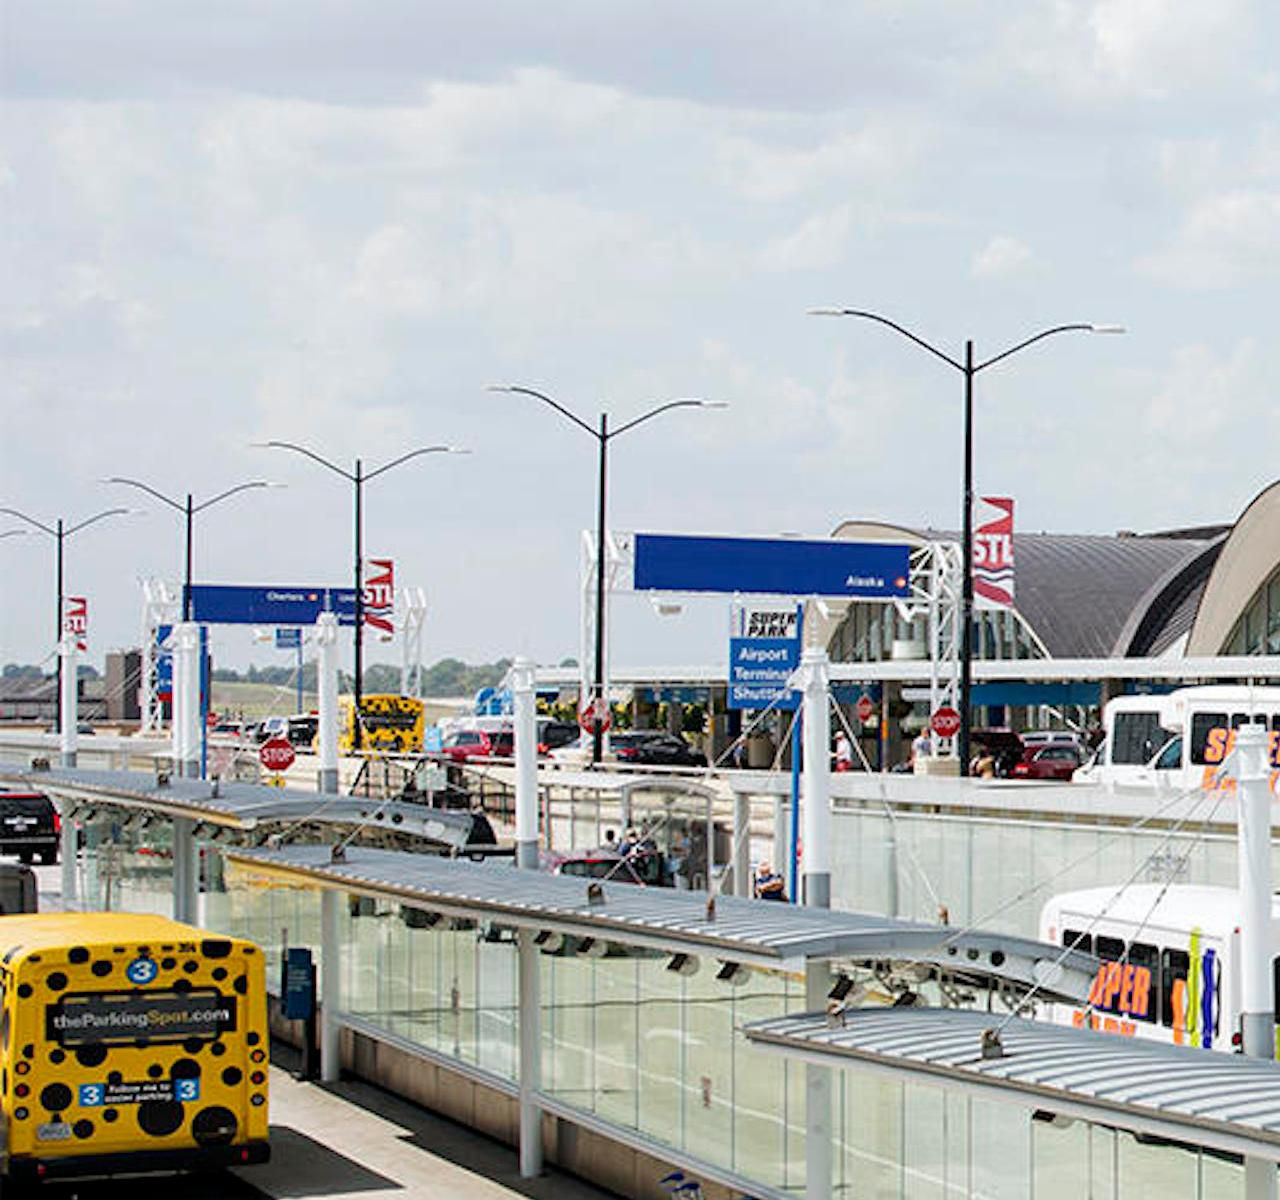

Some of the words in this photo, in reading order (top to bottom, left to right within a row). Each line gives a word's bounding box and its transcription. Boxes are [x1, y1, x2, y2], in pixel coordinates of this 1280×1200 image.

[974, 533, 1013, 563] STL
[846, 575, 884, 587] Alaska
[750, 612, 797, 625] SUPER
[748, 626, 787, 637] PARK
[739, 648, 789, 663] Airport
[262, 748, 292, 763] STOP
[134, 961, 151, 980] 3
[1089, 960, 1151, 1016] UPER
[53, 1008, 230, 1030] theParkingSpot.com
[83, 1086, 100, 1105] 3
[180, 1080, 196, 1099] 3
